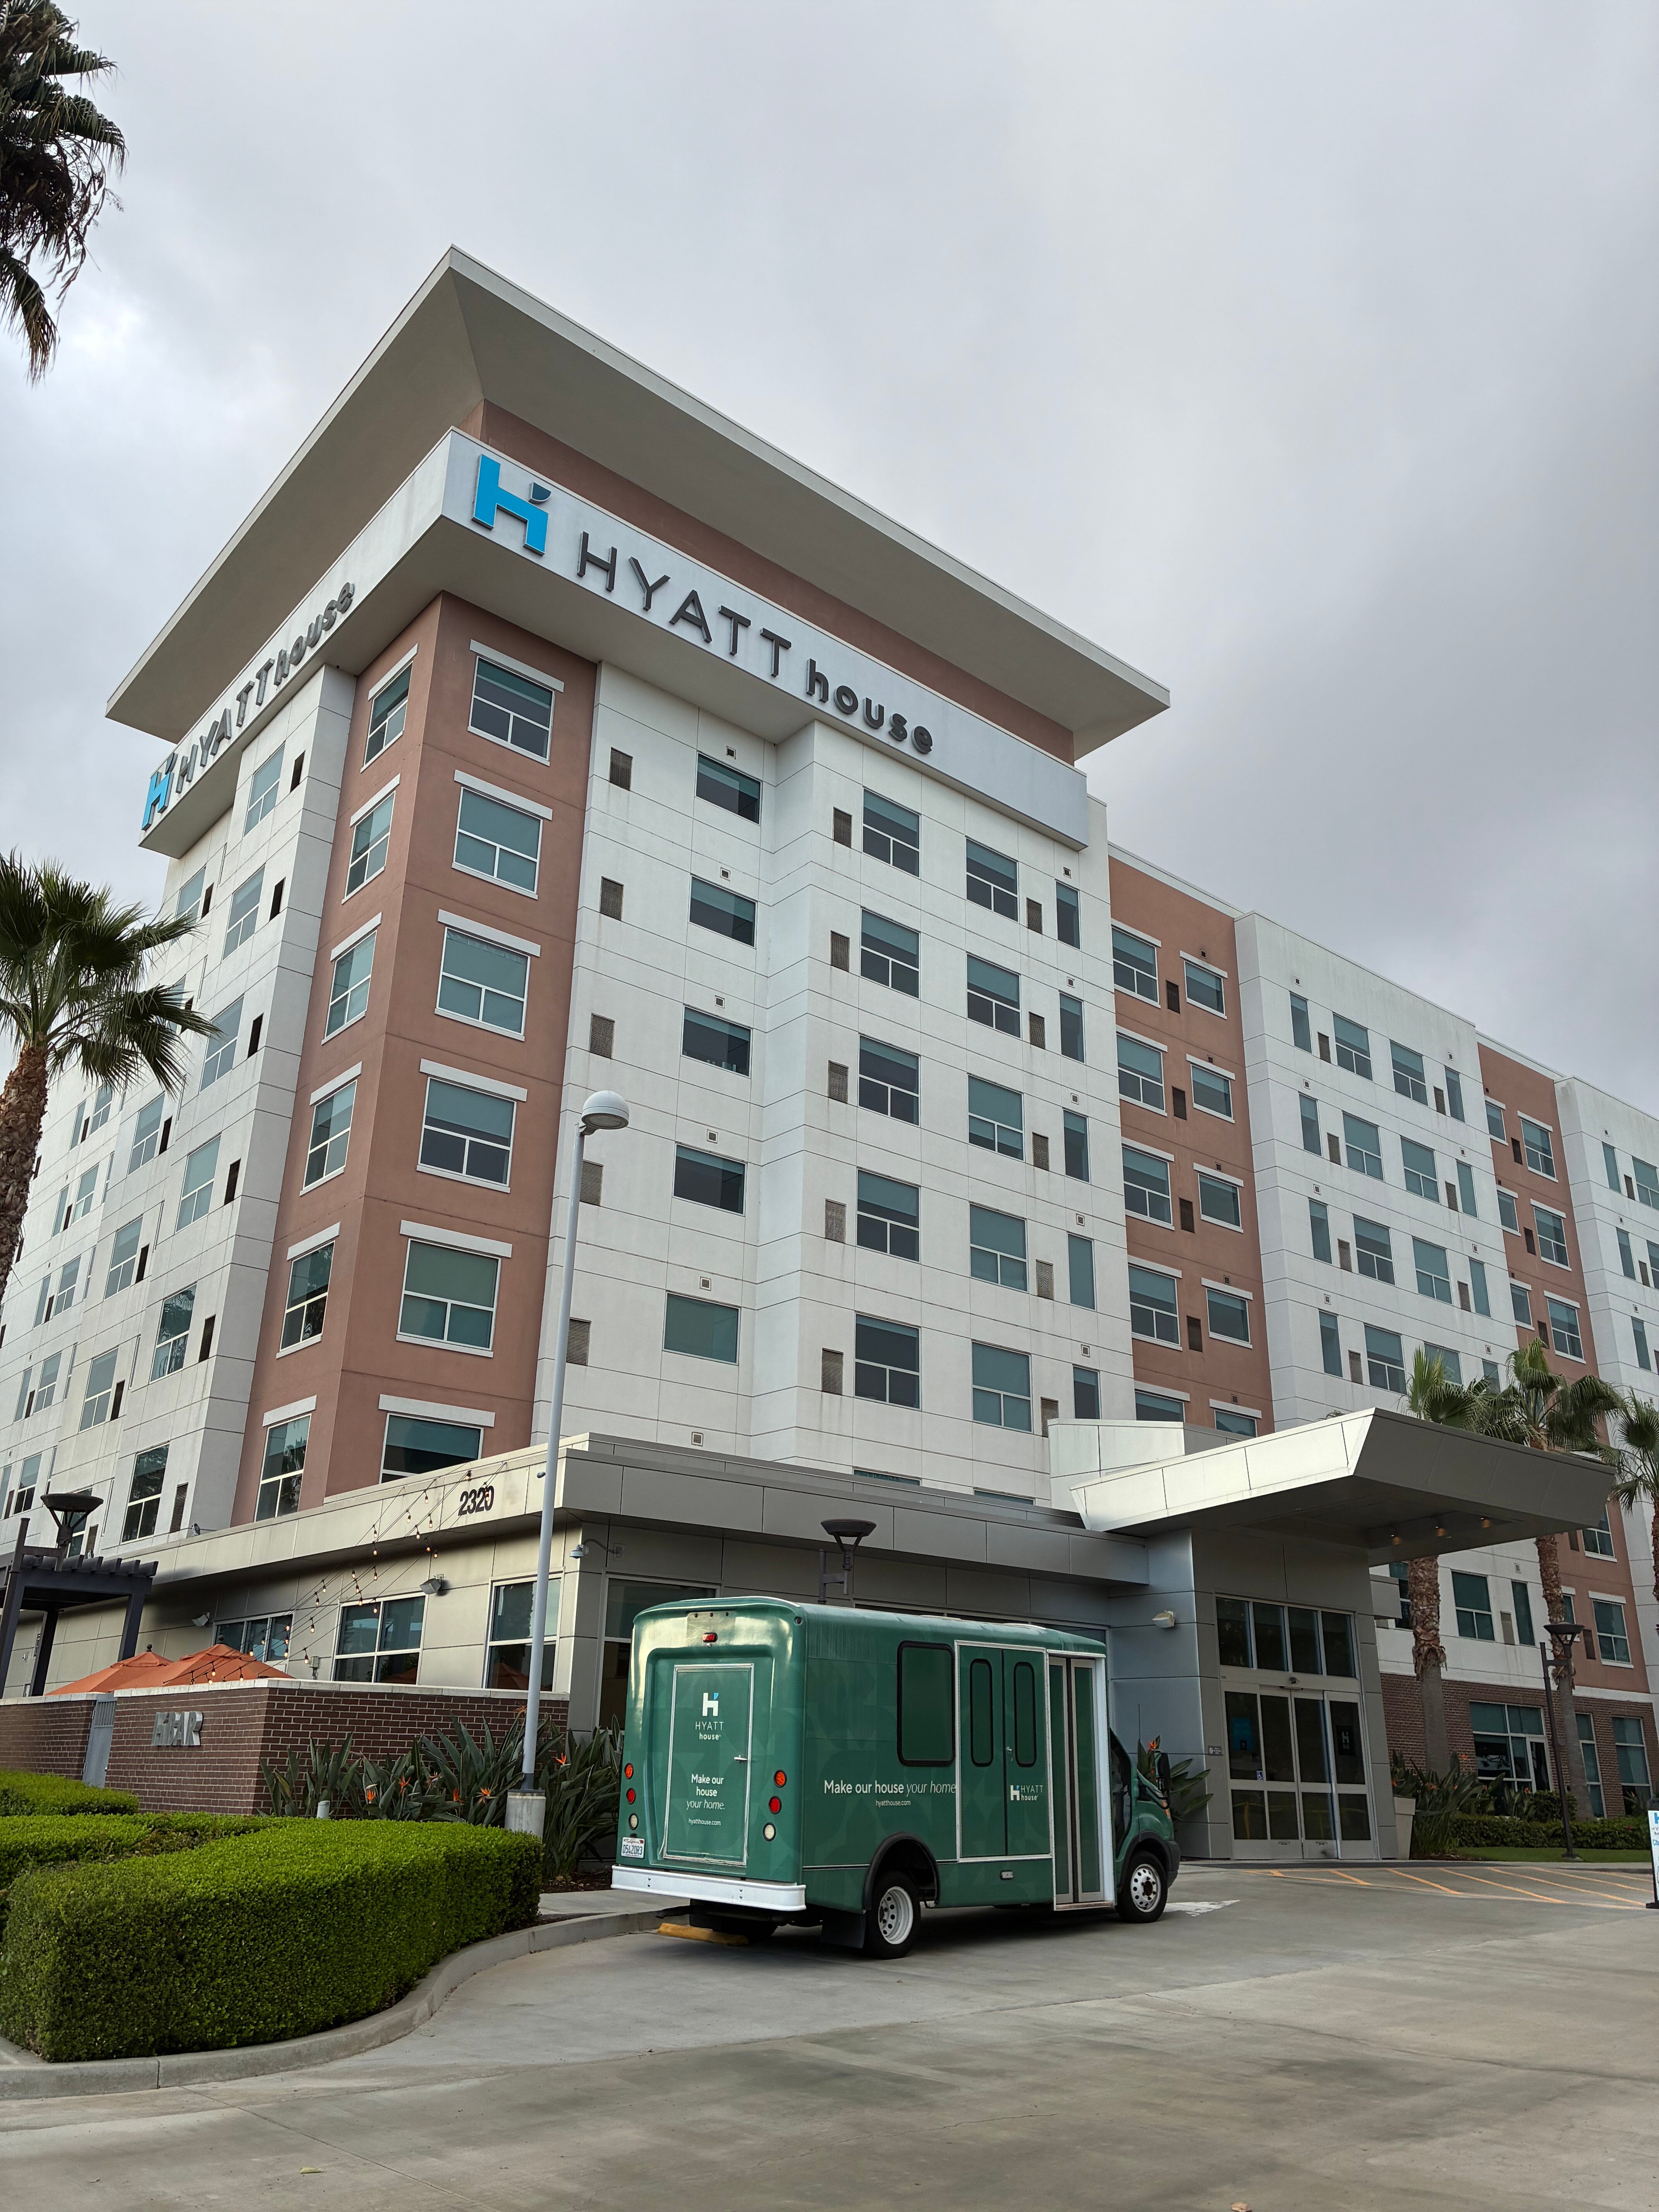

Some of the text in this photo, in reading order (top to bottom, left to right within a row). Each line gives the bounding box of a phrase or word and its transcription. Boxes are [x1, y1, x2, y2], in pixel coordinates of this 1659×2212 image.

[577, 531, 791, 677] HYATT
[806, 658, 933, 754] house
[175, 658, 275, 793] HYATT
[273, 582, 354, 685] house
[458, 1486, 494, 1516] 2320
[695, 1721, 724, 1730] HYATT
[691, 1774, 710, 1784] Make
[696, 1786, 717, 1796] house
[824, 1780, 956, 1797] Make our house your home
[686, 1799, 725, 1810] your home.
